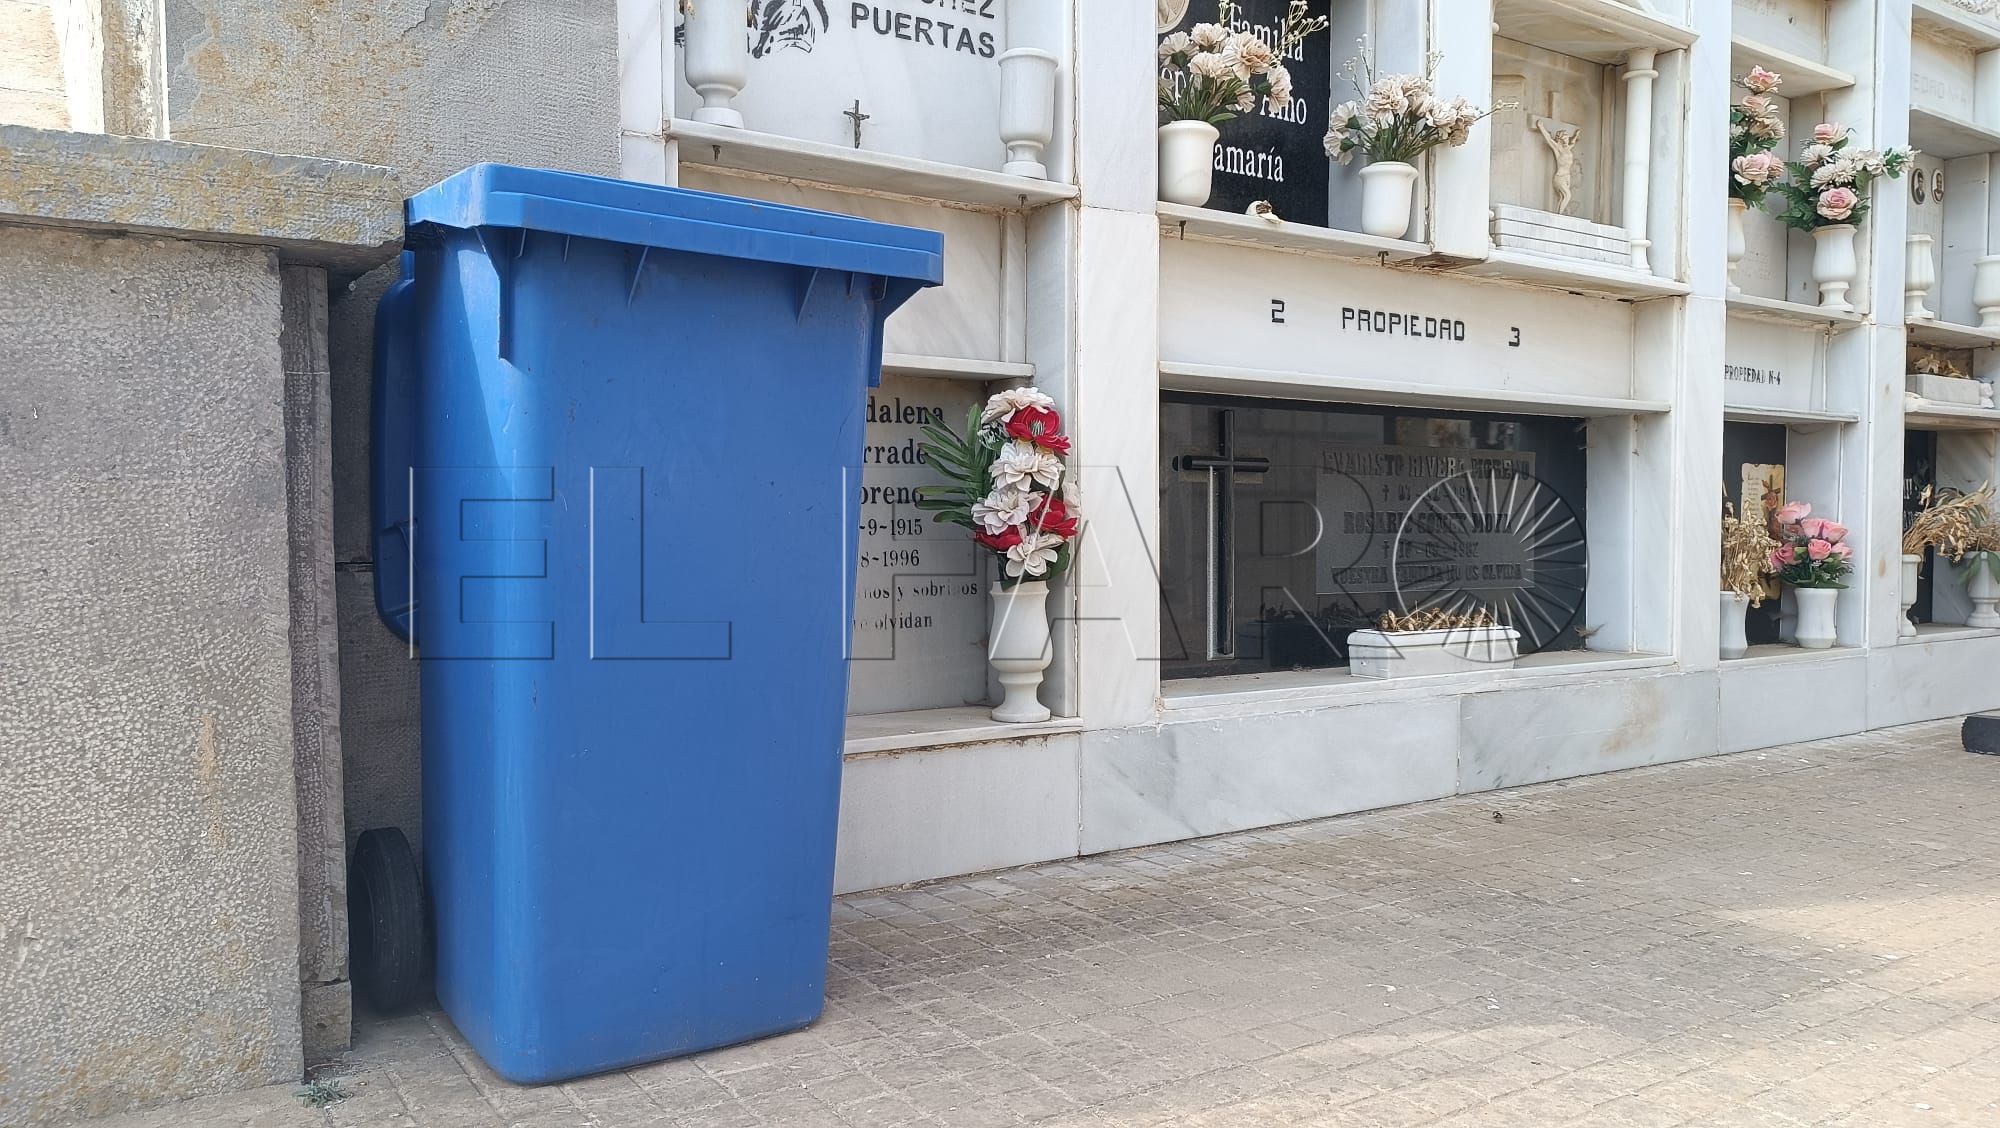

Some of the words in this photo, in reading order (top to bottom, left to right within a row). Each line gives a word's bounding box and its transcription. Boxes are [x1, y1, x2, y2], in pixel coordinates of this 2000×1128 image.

[851, 2, 996, 58] PUERTAS
[1214, 143, 1285, 183] amaría
[1271, 299, 1286, 324] 2
[1342, 307, 1466, 341] PROPIEDAD
[1508, 326, 1521, 348] 3
[913, 580, 978, 598] sobrios
